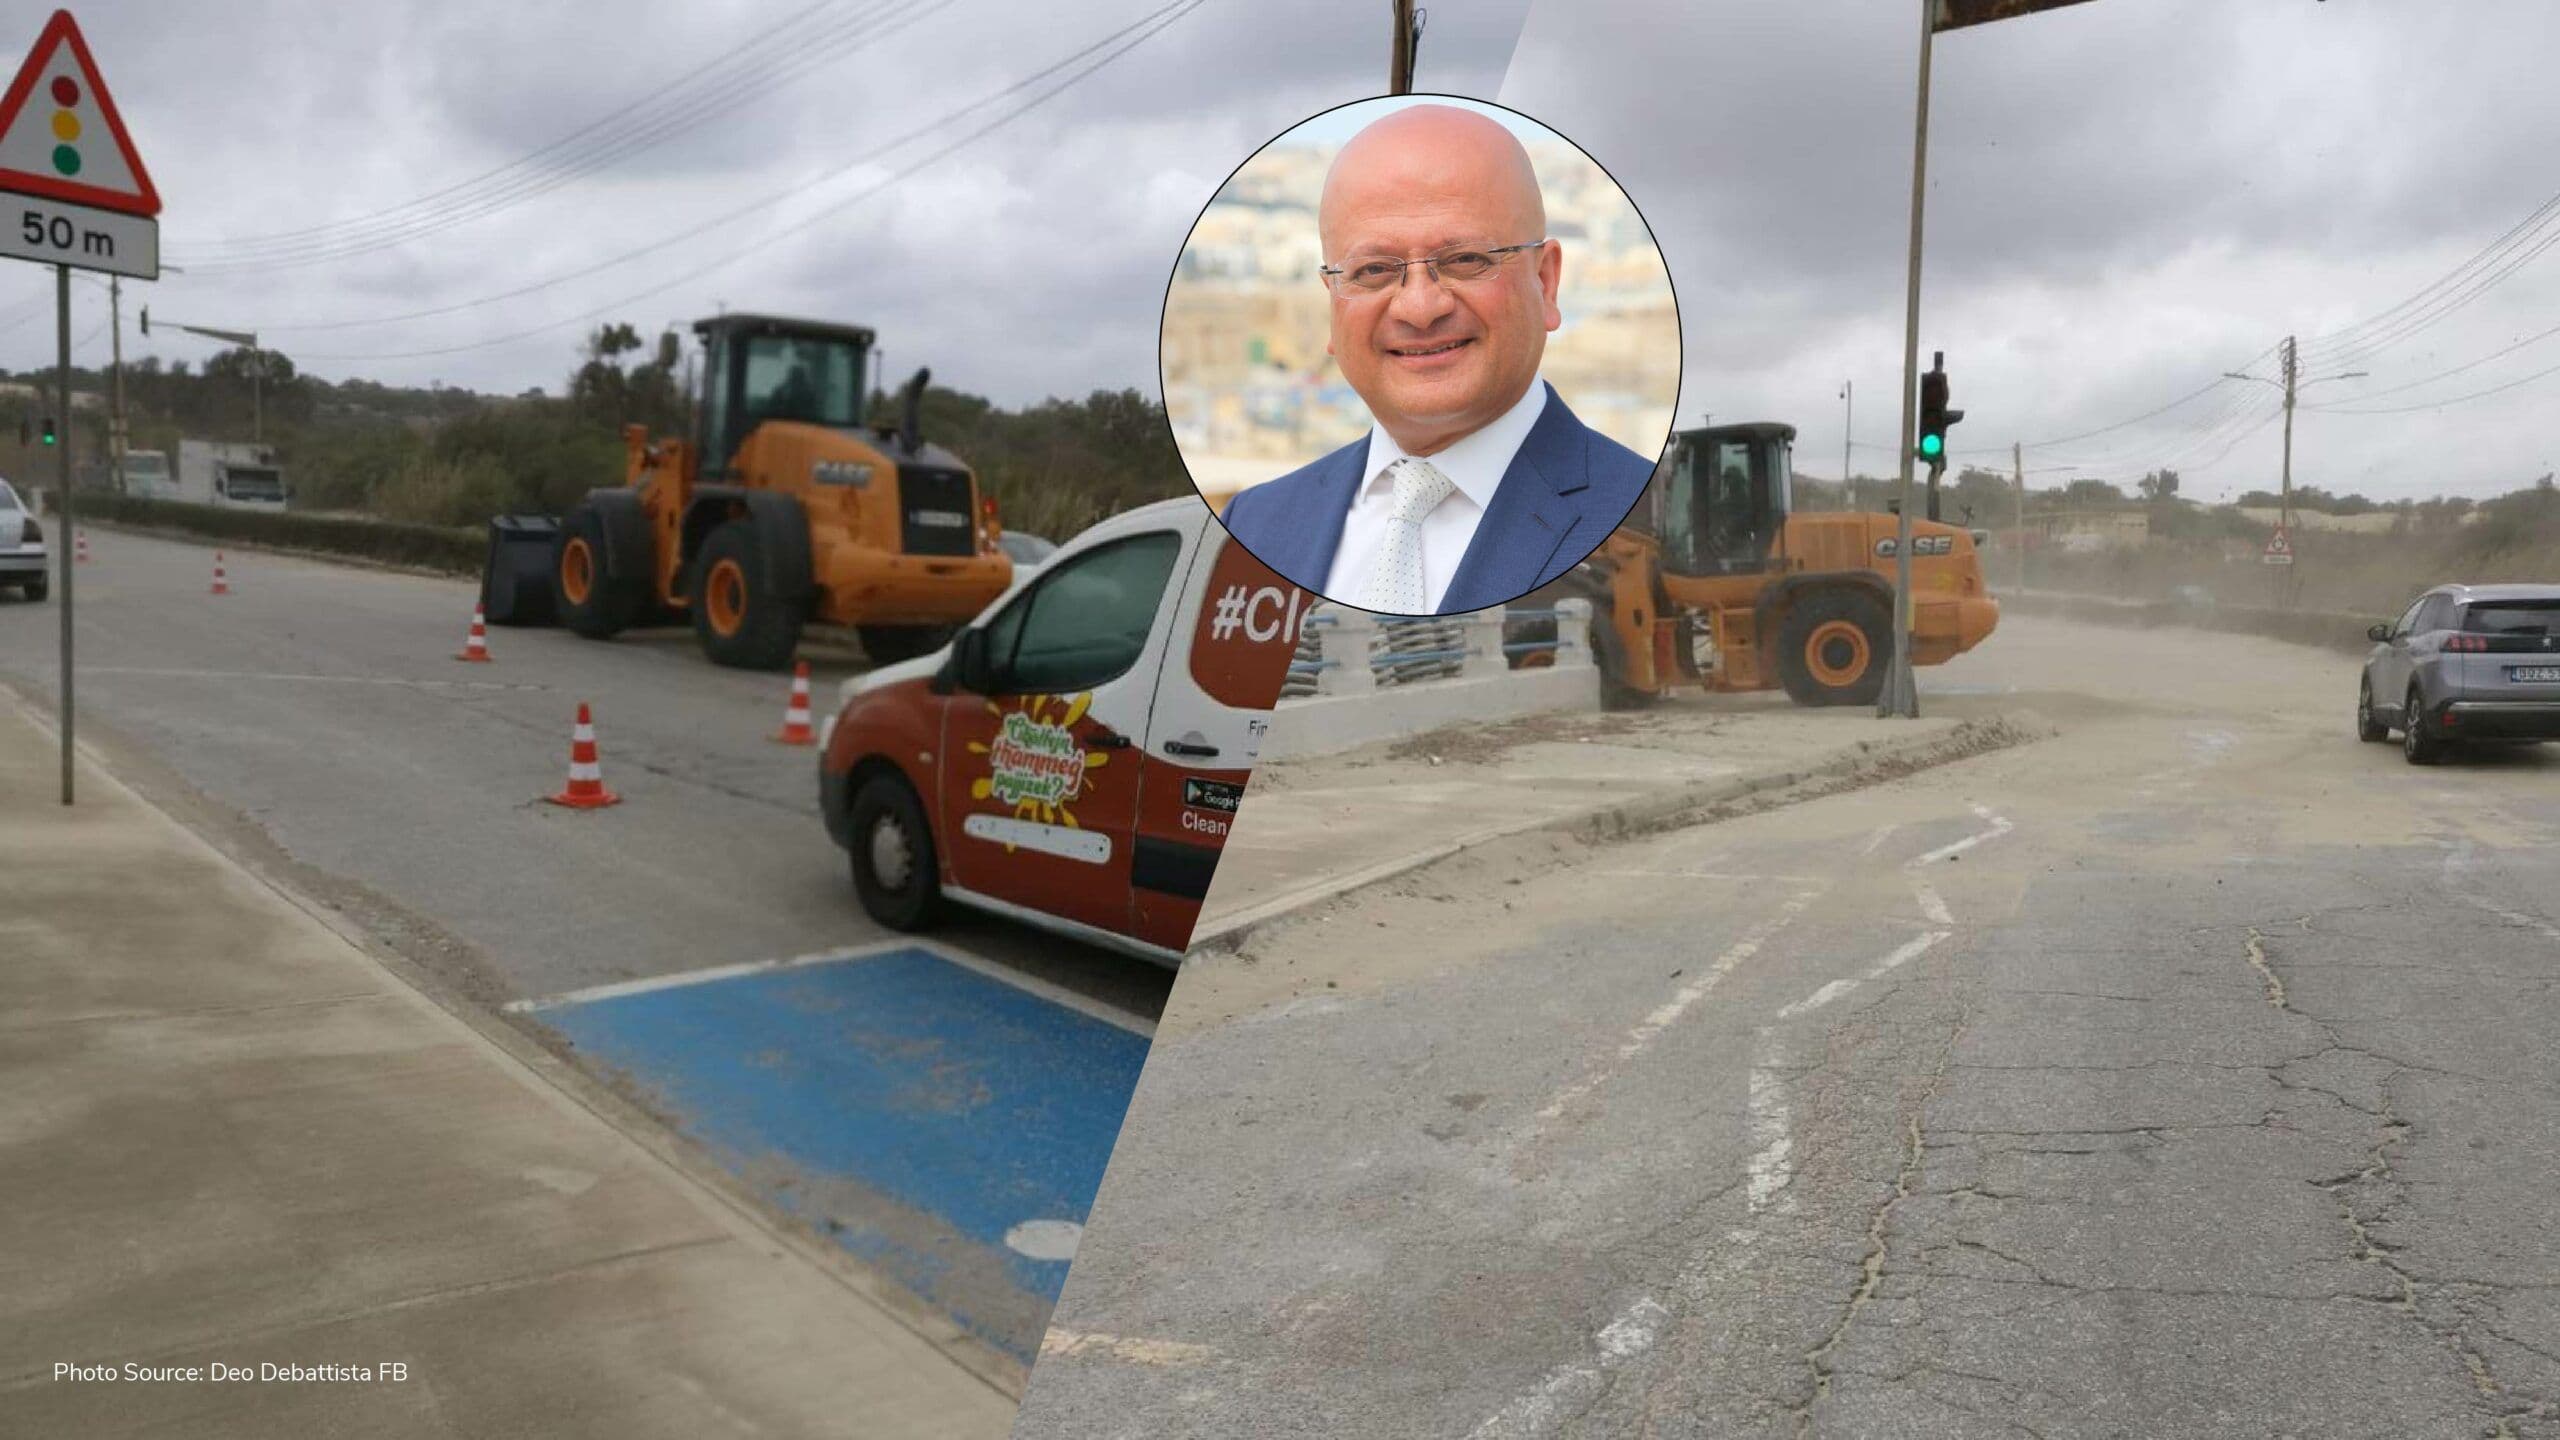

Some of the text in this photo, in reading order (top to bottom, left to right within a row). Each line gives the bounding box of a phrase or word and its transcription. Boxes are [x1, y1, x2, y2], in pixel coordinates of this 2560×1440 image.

[23, 210, 114, 257] 50 m
[1875, 535, 1952, 557] CSE
[1182, 811, 1228, 836] Clean
